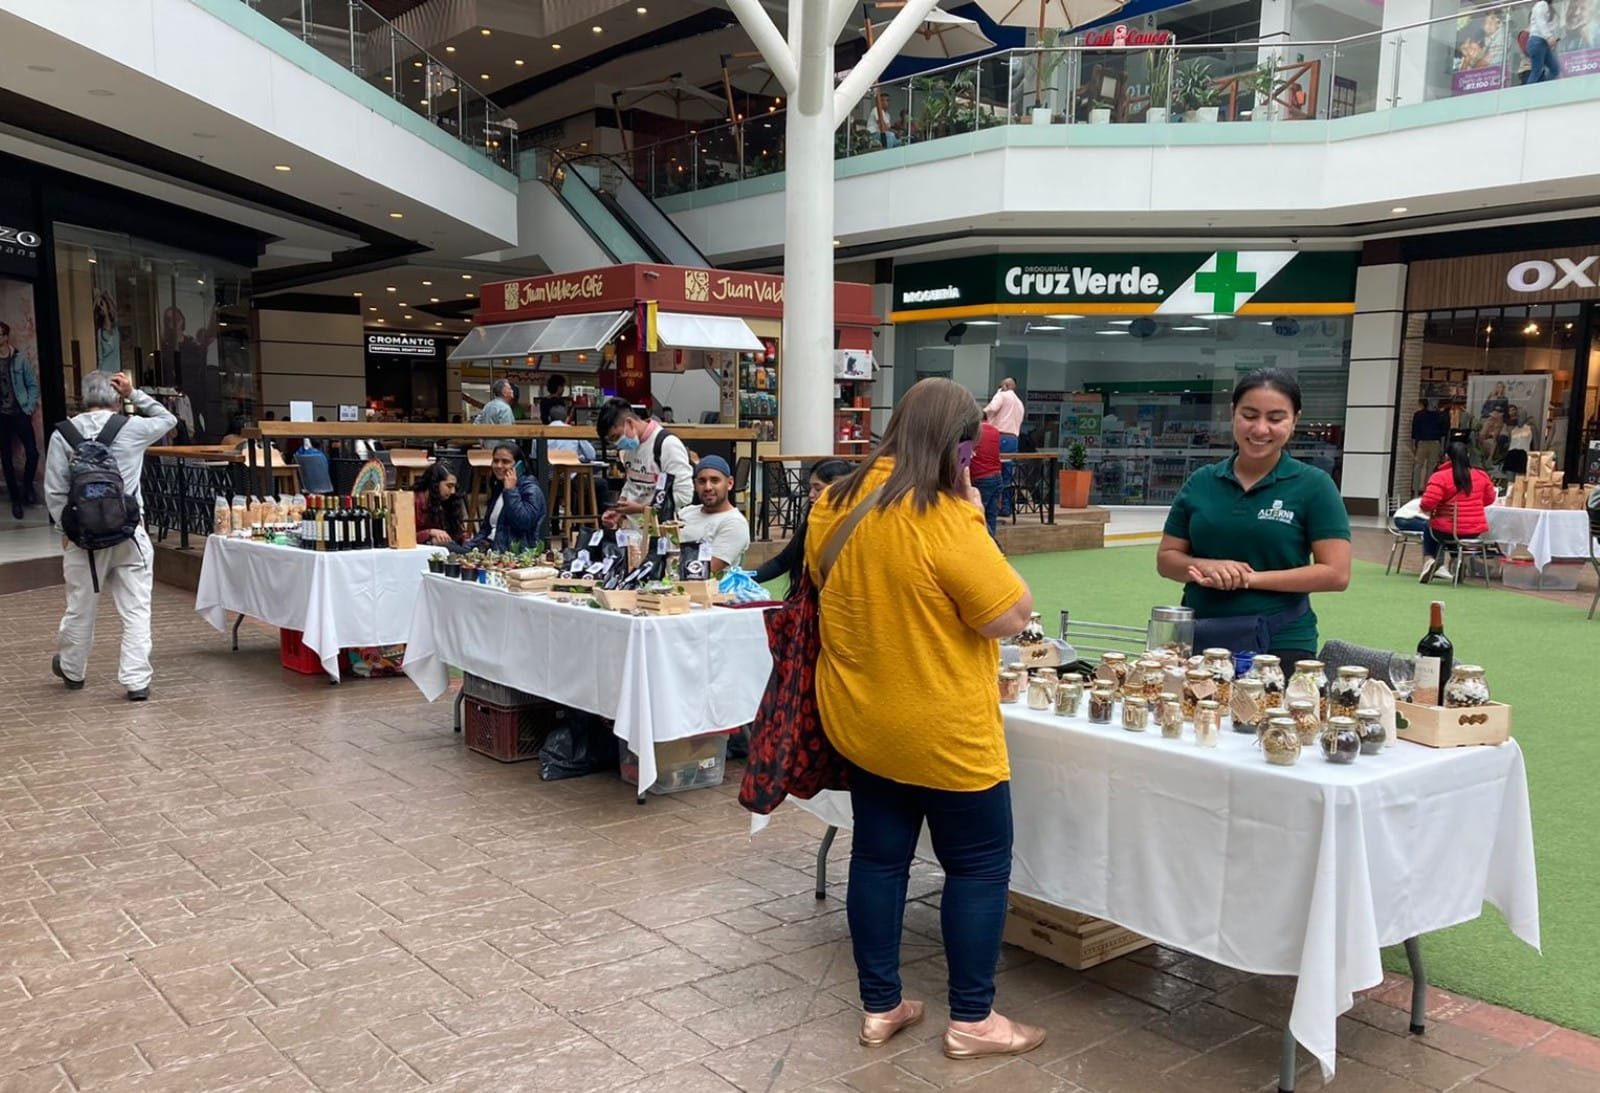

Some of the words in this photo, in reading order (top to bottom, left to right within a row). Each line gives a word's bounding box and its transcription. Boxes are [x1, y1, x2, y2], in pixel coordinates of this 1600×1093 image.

[0, 244, 37, 258] ans
[1024, 264, 1069, 273] DROGUERÍAS
[1506, 255, 1600, 292] OX
[520, 282, 546, 306] Juan
[581, 274, 604, 299] Café
[712, 276, 754, 300] Juan
[1005, 266, 1071, 296] Cruz
[368, 335, 435, 346] CROMANTIC
[1079, 417, 1097, 430] 20
